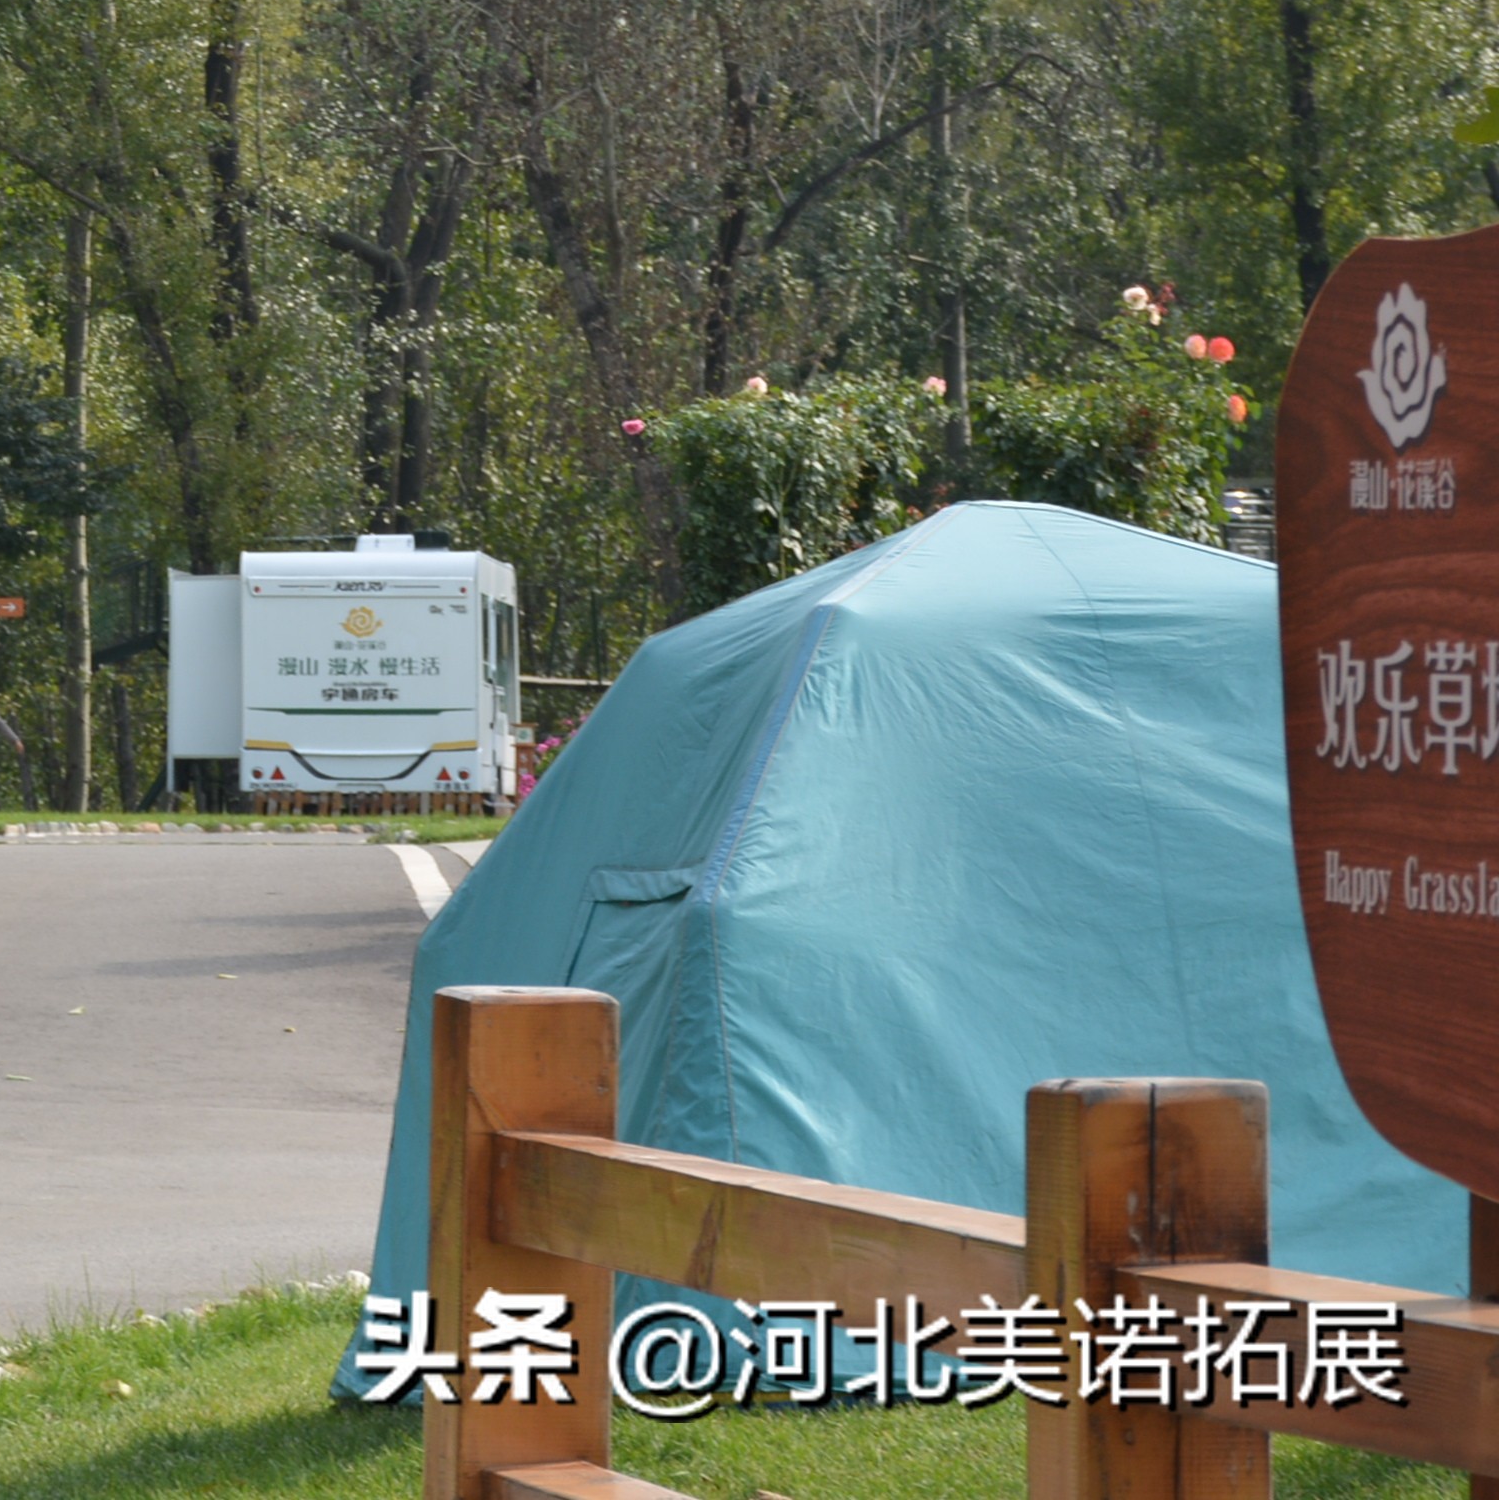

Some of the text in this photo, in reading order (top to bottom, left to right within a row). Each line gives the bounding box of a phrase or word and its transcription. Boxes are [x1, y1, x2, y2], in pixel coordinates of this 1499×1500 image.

[278, 657, 441, 676] 漫山 漫水 慢生活
[321, 687, 400, 702] 宇通房车
[1324, 850, 1393, 915] Happy
